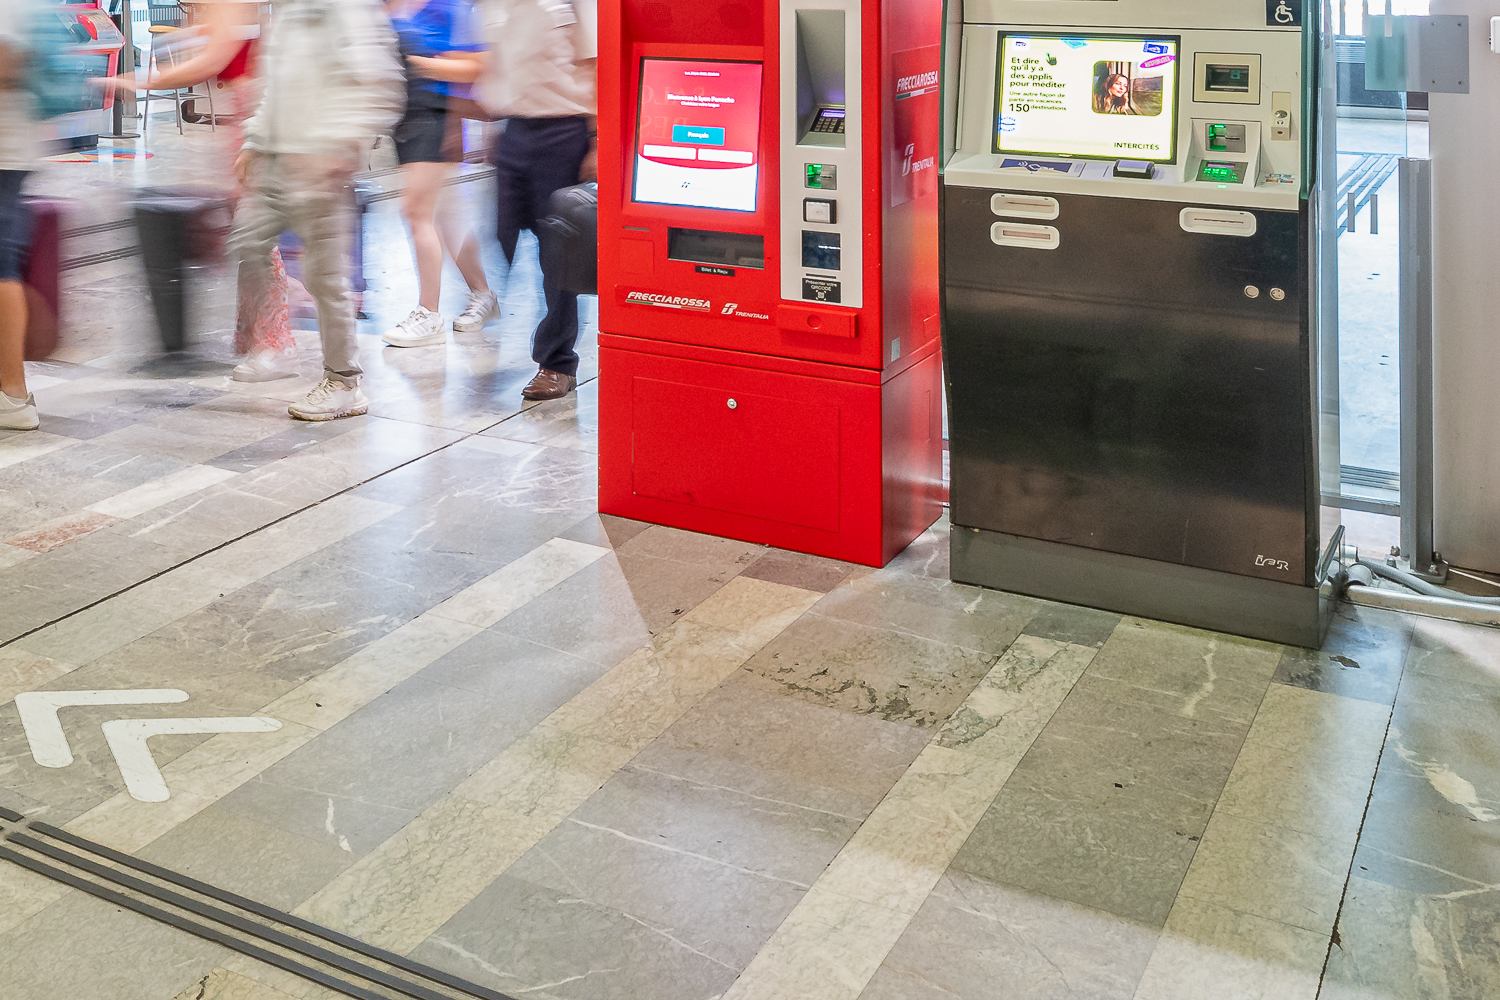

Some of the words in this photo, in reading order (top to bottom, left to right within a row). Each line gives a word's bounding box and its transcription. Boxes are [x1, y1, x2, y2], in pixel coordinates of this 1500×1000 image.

[1023, 57, 1040, 65] dire
[1011, 64, 1029, 73] qu'il
[896, 70, 938, 93] FRECCIAROSSA
[1010, 72, 1025, 80] des
[1027, 72, 1053, 82] applis
[1010, 81, 1030, 89] pour
[1032, 80, 1066, 88] méditer
[1009, 103, 1030, 113] 150
[1113, 141, 1160, 151] INTERCITÉS
[912, 156, 934, 174] TRENITALIA
[627, 291, 711, 308] FRECCIAROSSA
[735, 311, 769, 319] TRENITALIA
